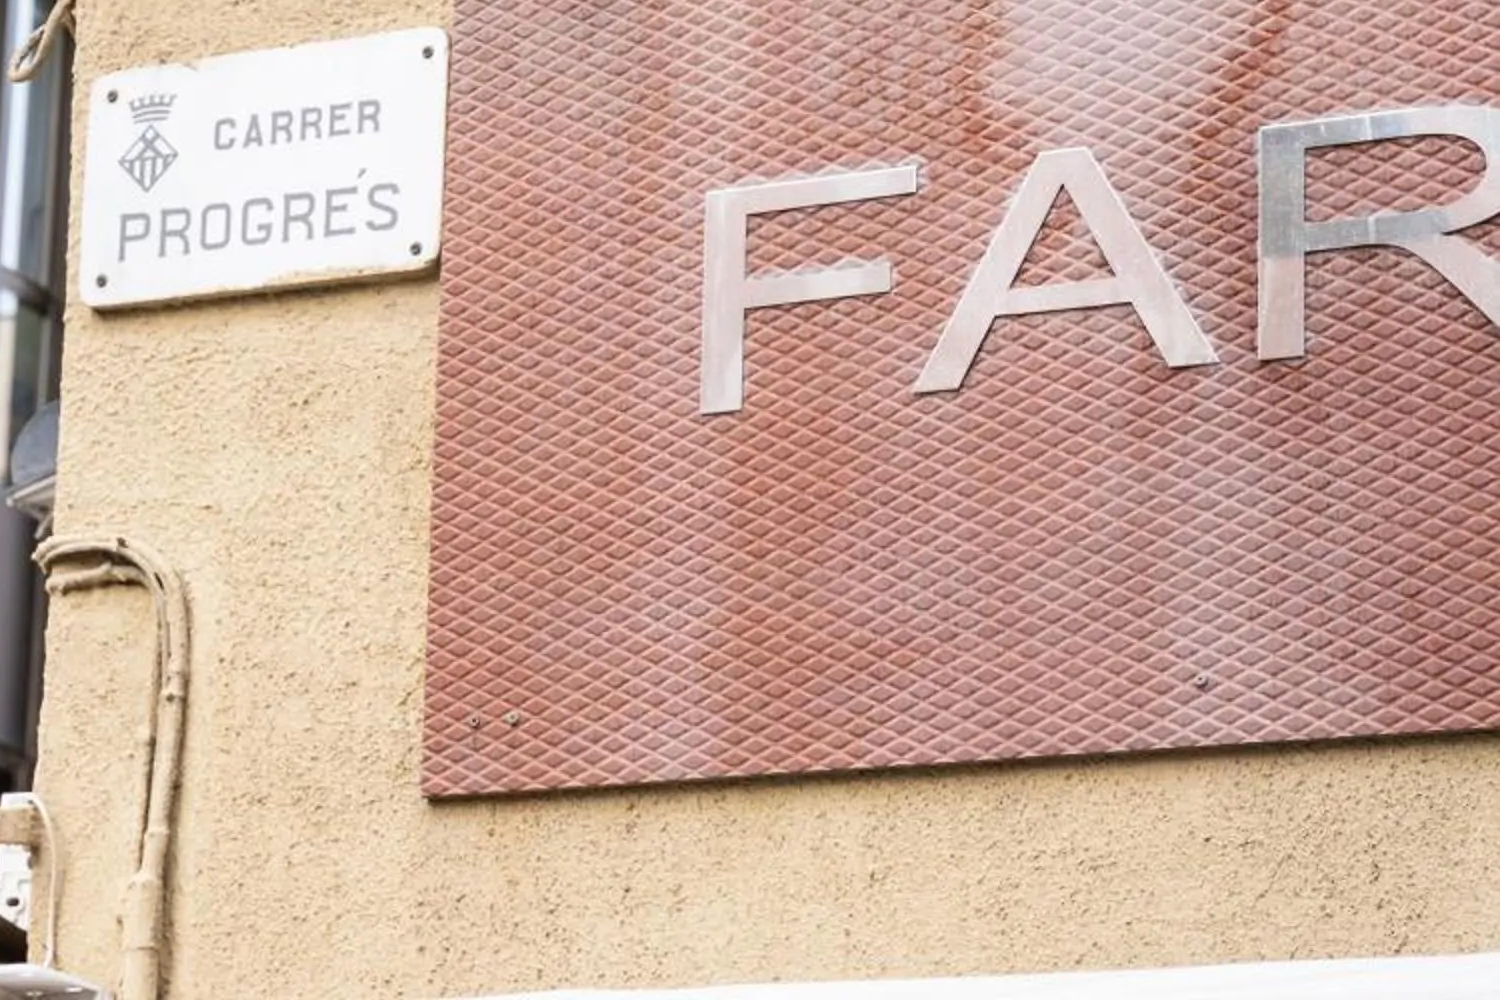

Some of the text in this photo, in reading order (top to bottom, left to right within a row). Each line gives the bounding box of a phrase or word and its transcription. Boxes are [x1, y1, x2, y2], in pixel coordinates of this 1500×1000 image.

[214, 100, 381, 150] CARRER
[118, 169, 399, 262] PROGRÉS
[700, 105, 1500, 415] FAR
